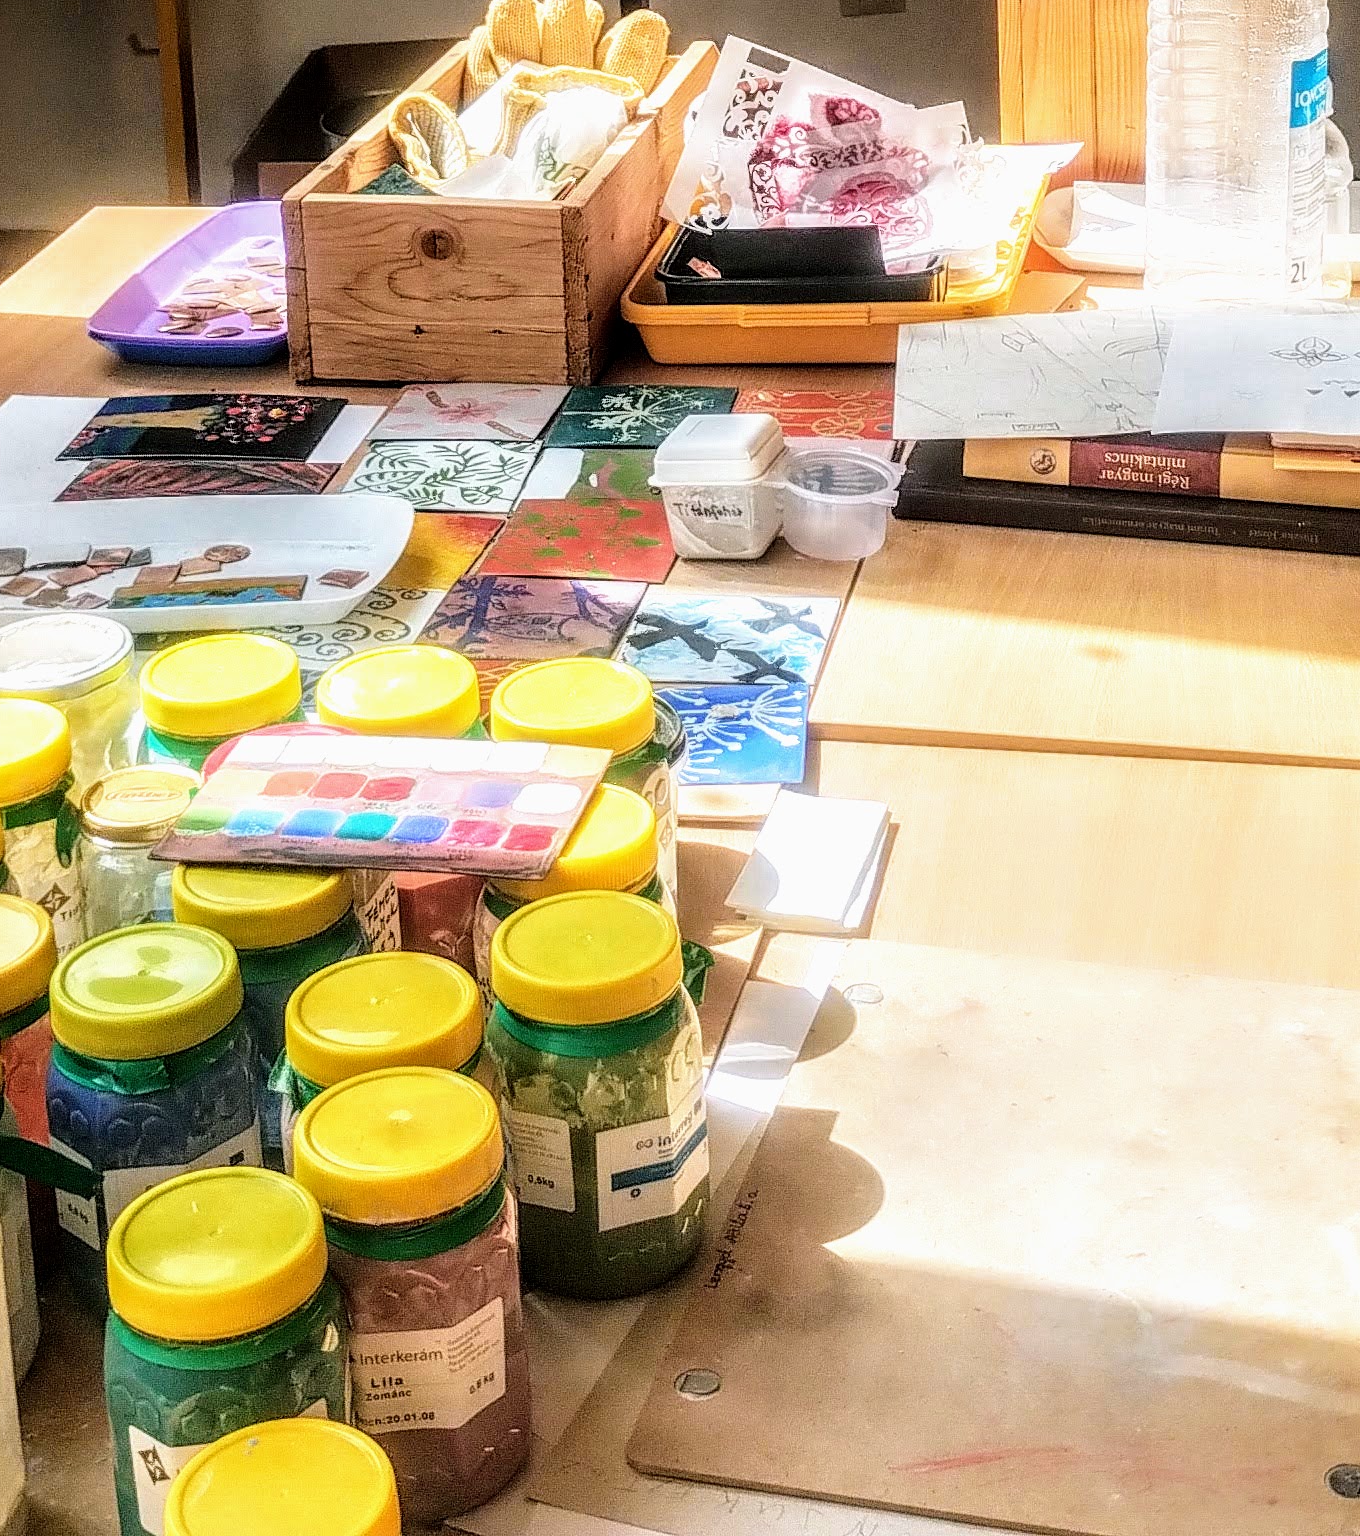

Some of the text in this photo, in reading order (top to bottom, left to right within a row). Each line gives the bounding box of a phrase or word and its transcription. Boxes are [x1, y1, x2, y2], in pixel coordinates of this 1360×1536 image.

[1104, 452, 1186, 471] mintakincs
[1098, 467, 1190, 490] Régi magyar
[359, 1348, 443, 1365] Interkerám
[370, 1376, 404, 1389] Lila
[365, 1389, 412, 1402] Zománc
